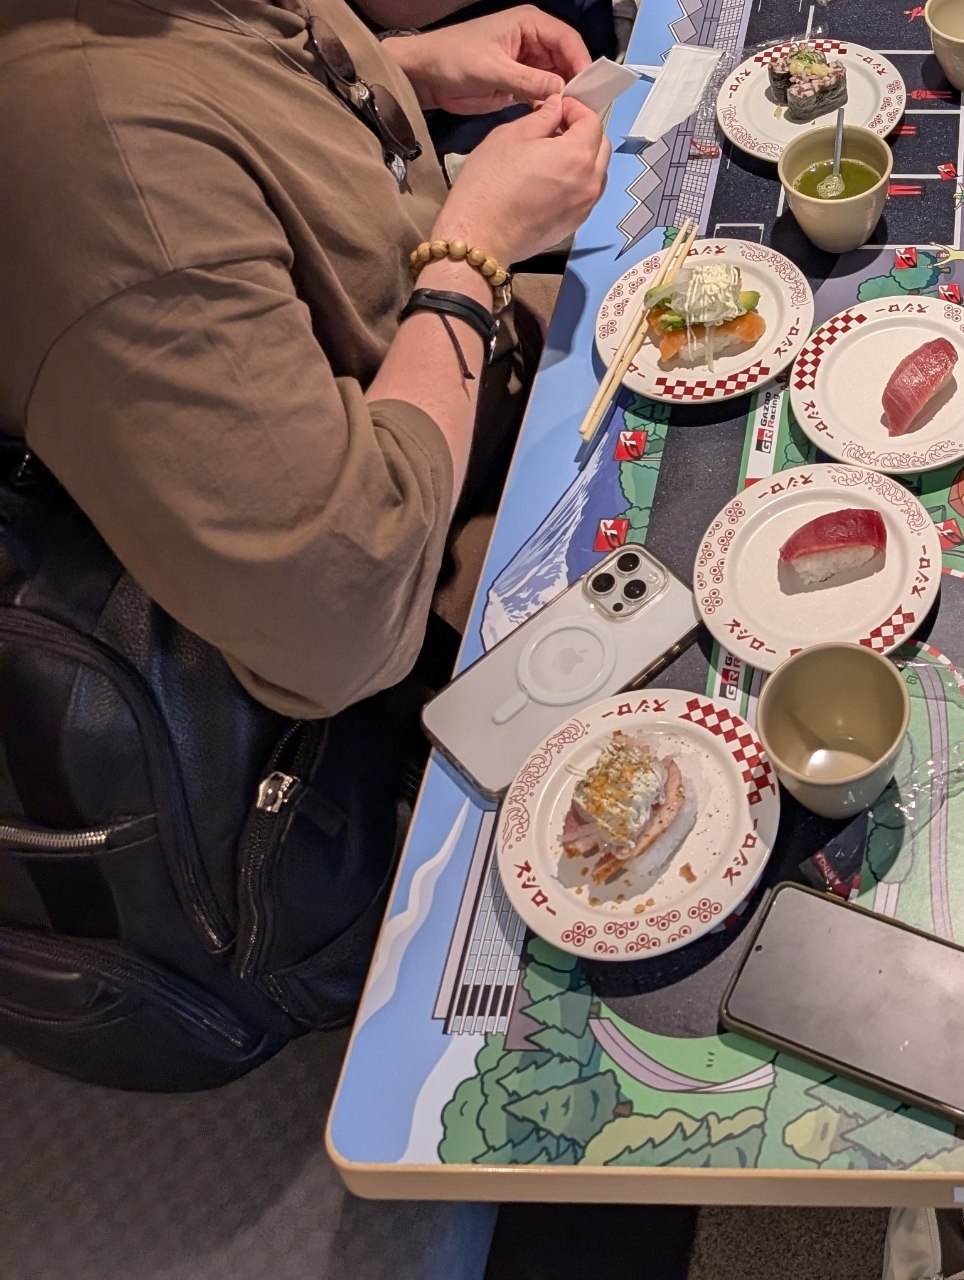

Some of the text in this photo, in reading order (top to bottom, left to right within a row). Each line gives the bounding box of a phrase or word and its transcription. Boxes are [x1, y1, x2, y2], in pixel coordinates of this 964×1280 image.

[856, 52, 887, 76] スシロー
[729, 69, 752, 99] スシロー
[685, 245, 728, 257] スシロ
[875, 303, 930, 314] スシロー
[773, 317, 801, 358] スシロー
[760, 391, 771, 427] GAZOO
[767, 393, 779, 429] Racing
[802, 399, 835, 439] スシロー
[758, 429, 774, 454] GR
[758, 472, 814, 499] スシロー
[911, 544, 931, 599] スシロー
[723, 617, 777, 655] スシロー
[723, 670, 740, 700] GR
[602, 698, 670, 718] スシロー
[723, 818, 758, 886] スシロー
[513, 860, 556, 916] スシロー
